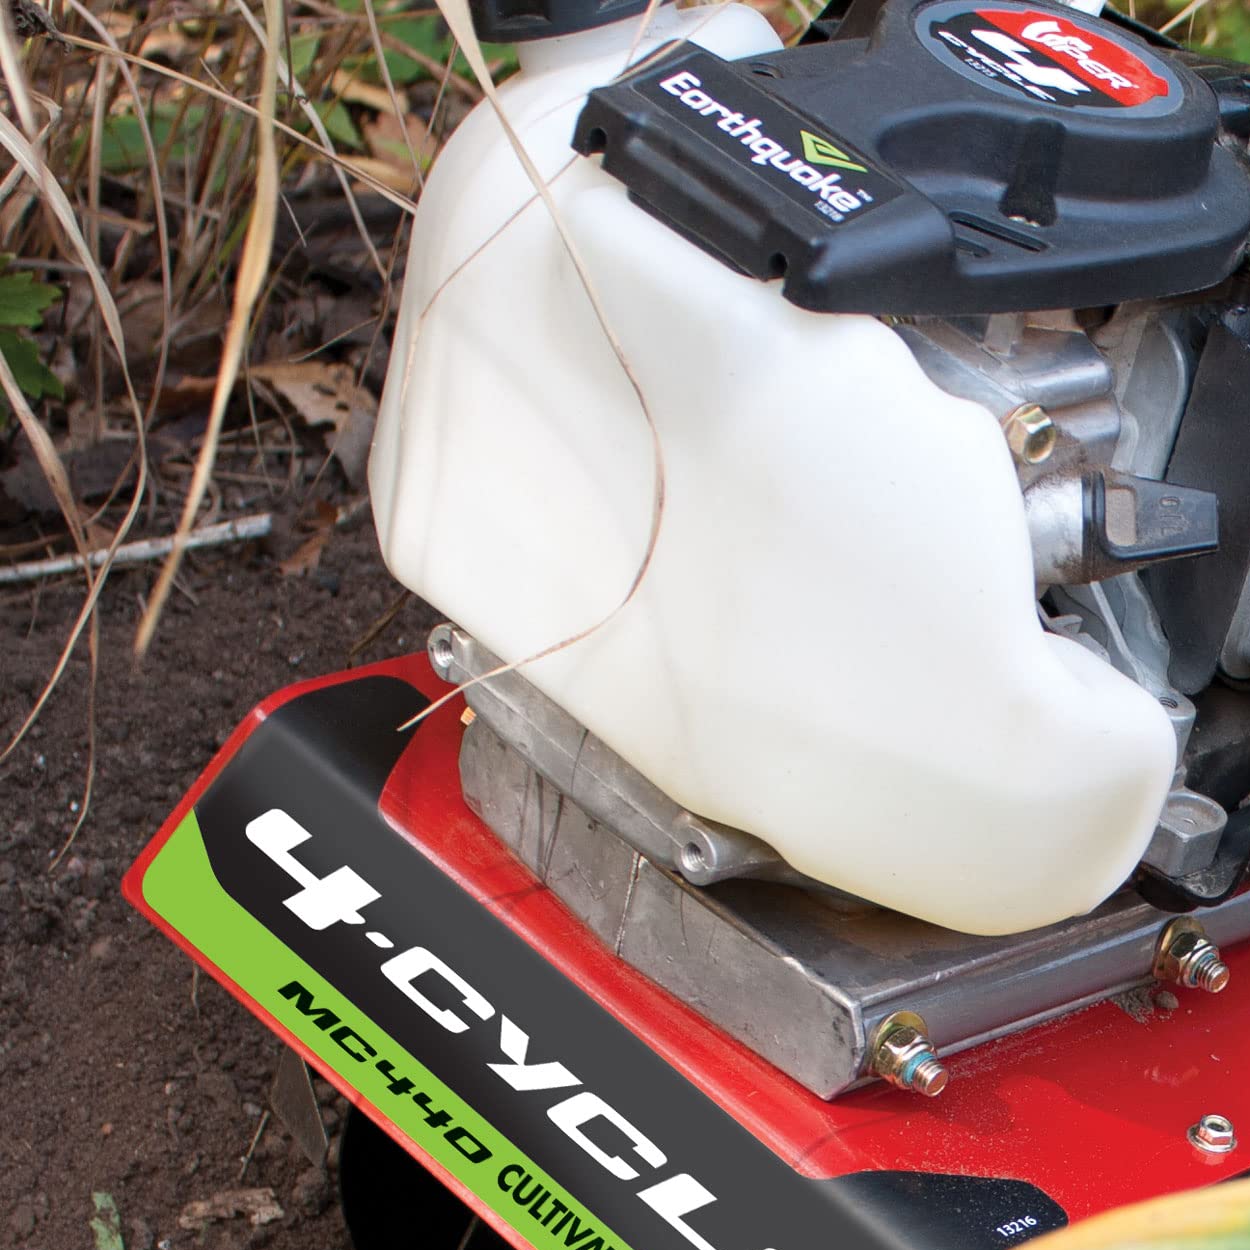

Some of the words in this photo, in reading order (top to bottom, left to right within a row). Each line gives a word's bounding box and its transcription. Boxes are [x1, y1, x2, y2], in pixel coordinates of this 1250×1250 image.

[659, 71, 862, 213] Earthquake
[277, 981, 493, 1164] MC440
[996, 1215, 1037, 1237] 13216
